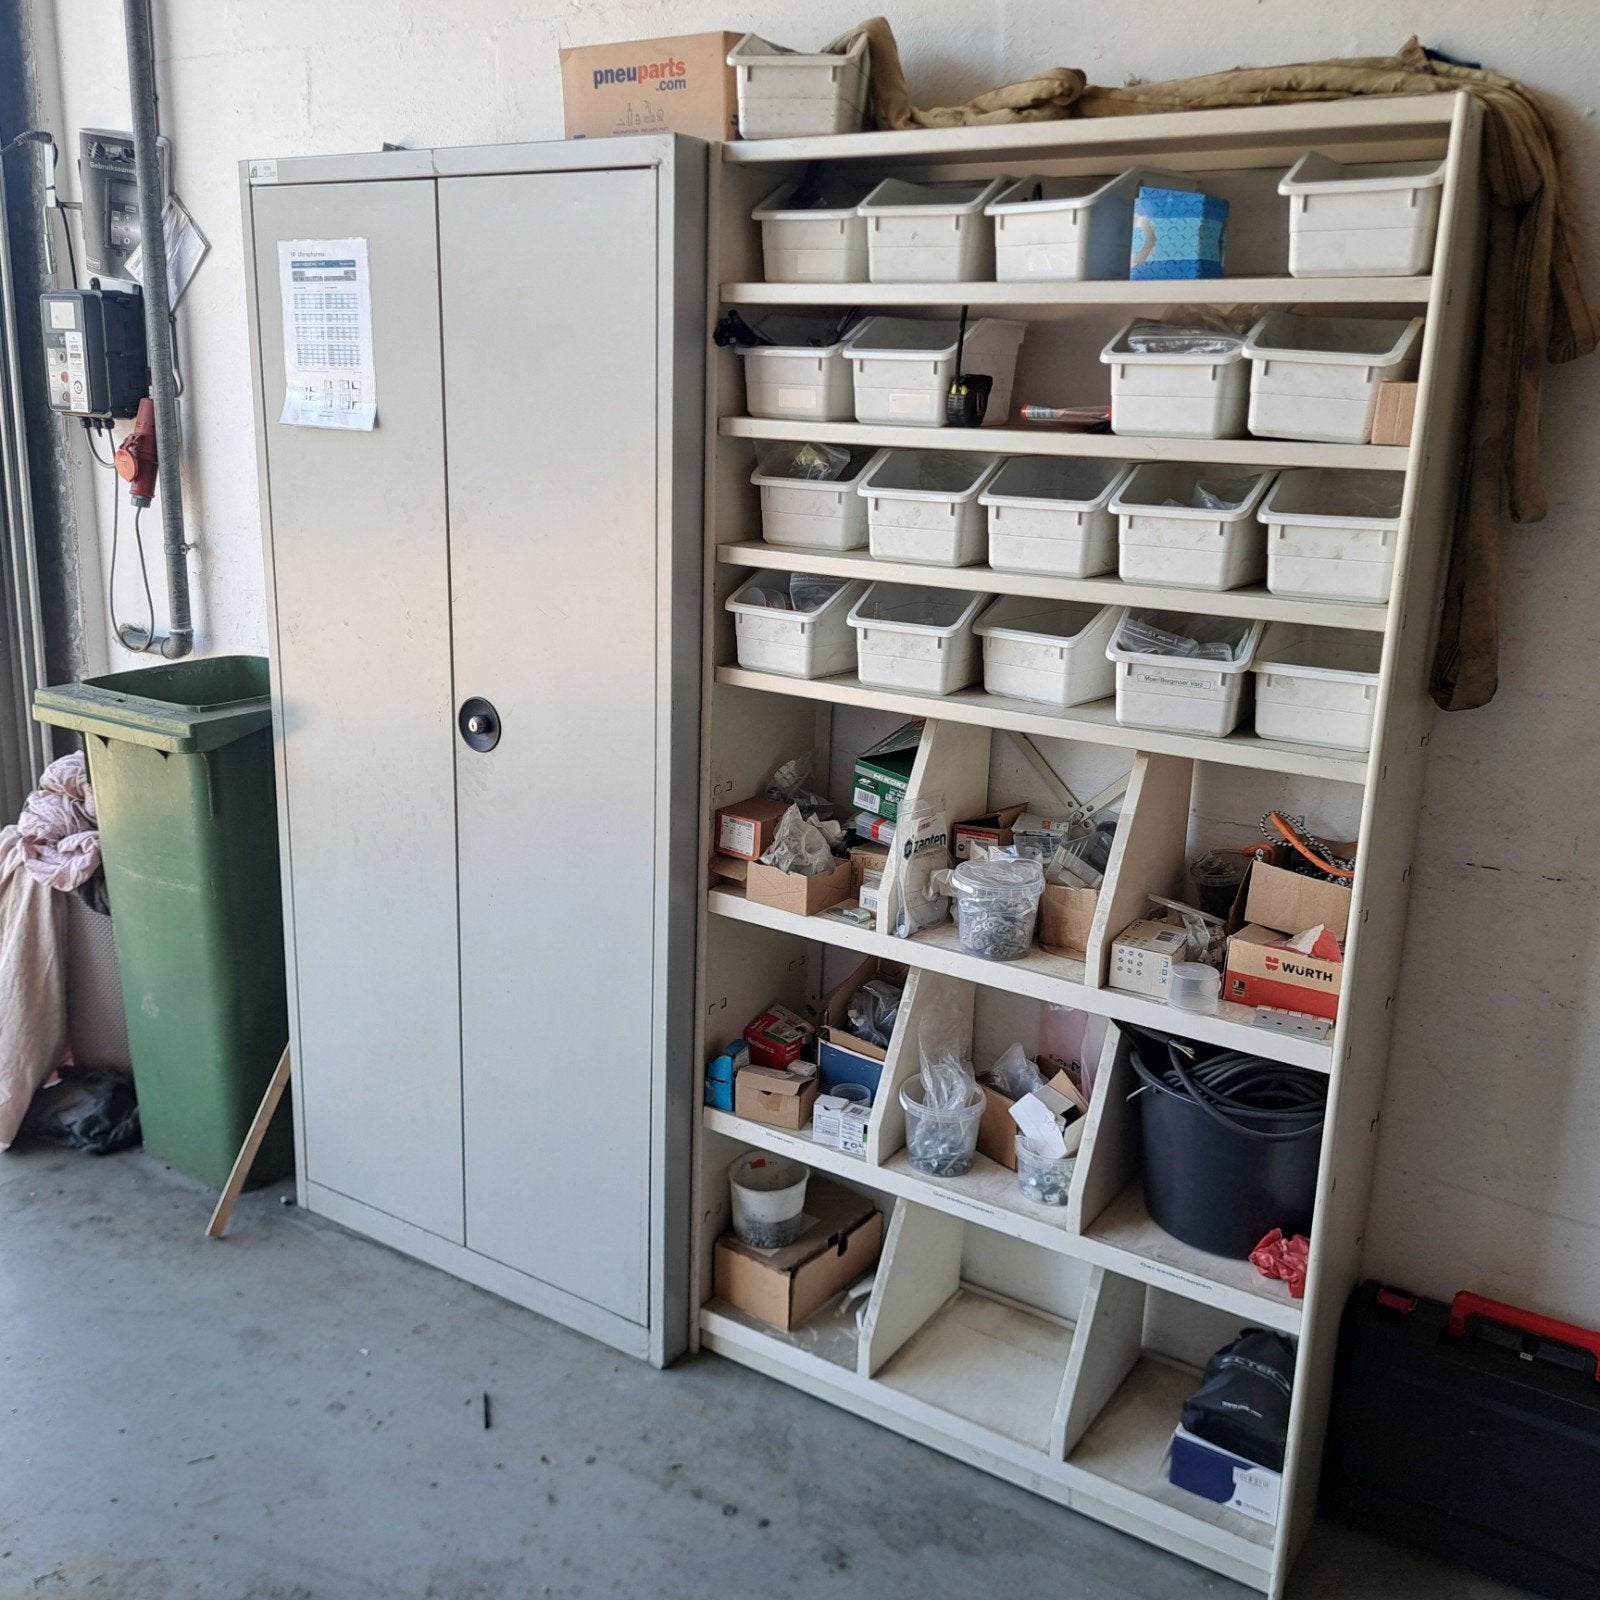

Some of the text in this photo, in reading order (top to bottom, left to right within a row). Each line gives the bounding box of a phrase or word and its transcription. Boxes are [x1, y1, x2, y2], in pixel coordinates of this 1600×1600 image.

[593, 57, 686, 89] pneuparts
[656, 78, 686, 91] .com
[914, 833, 947, 853] zanten
[1282, 962, 1333, 982] WÜRTH
